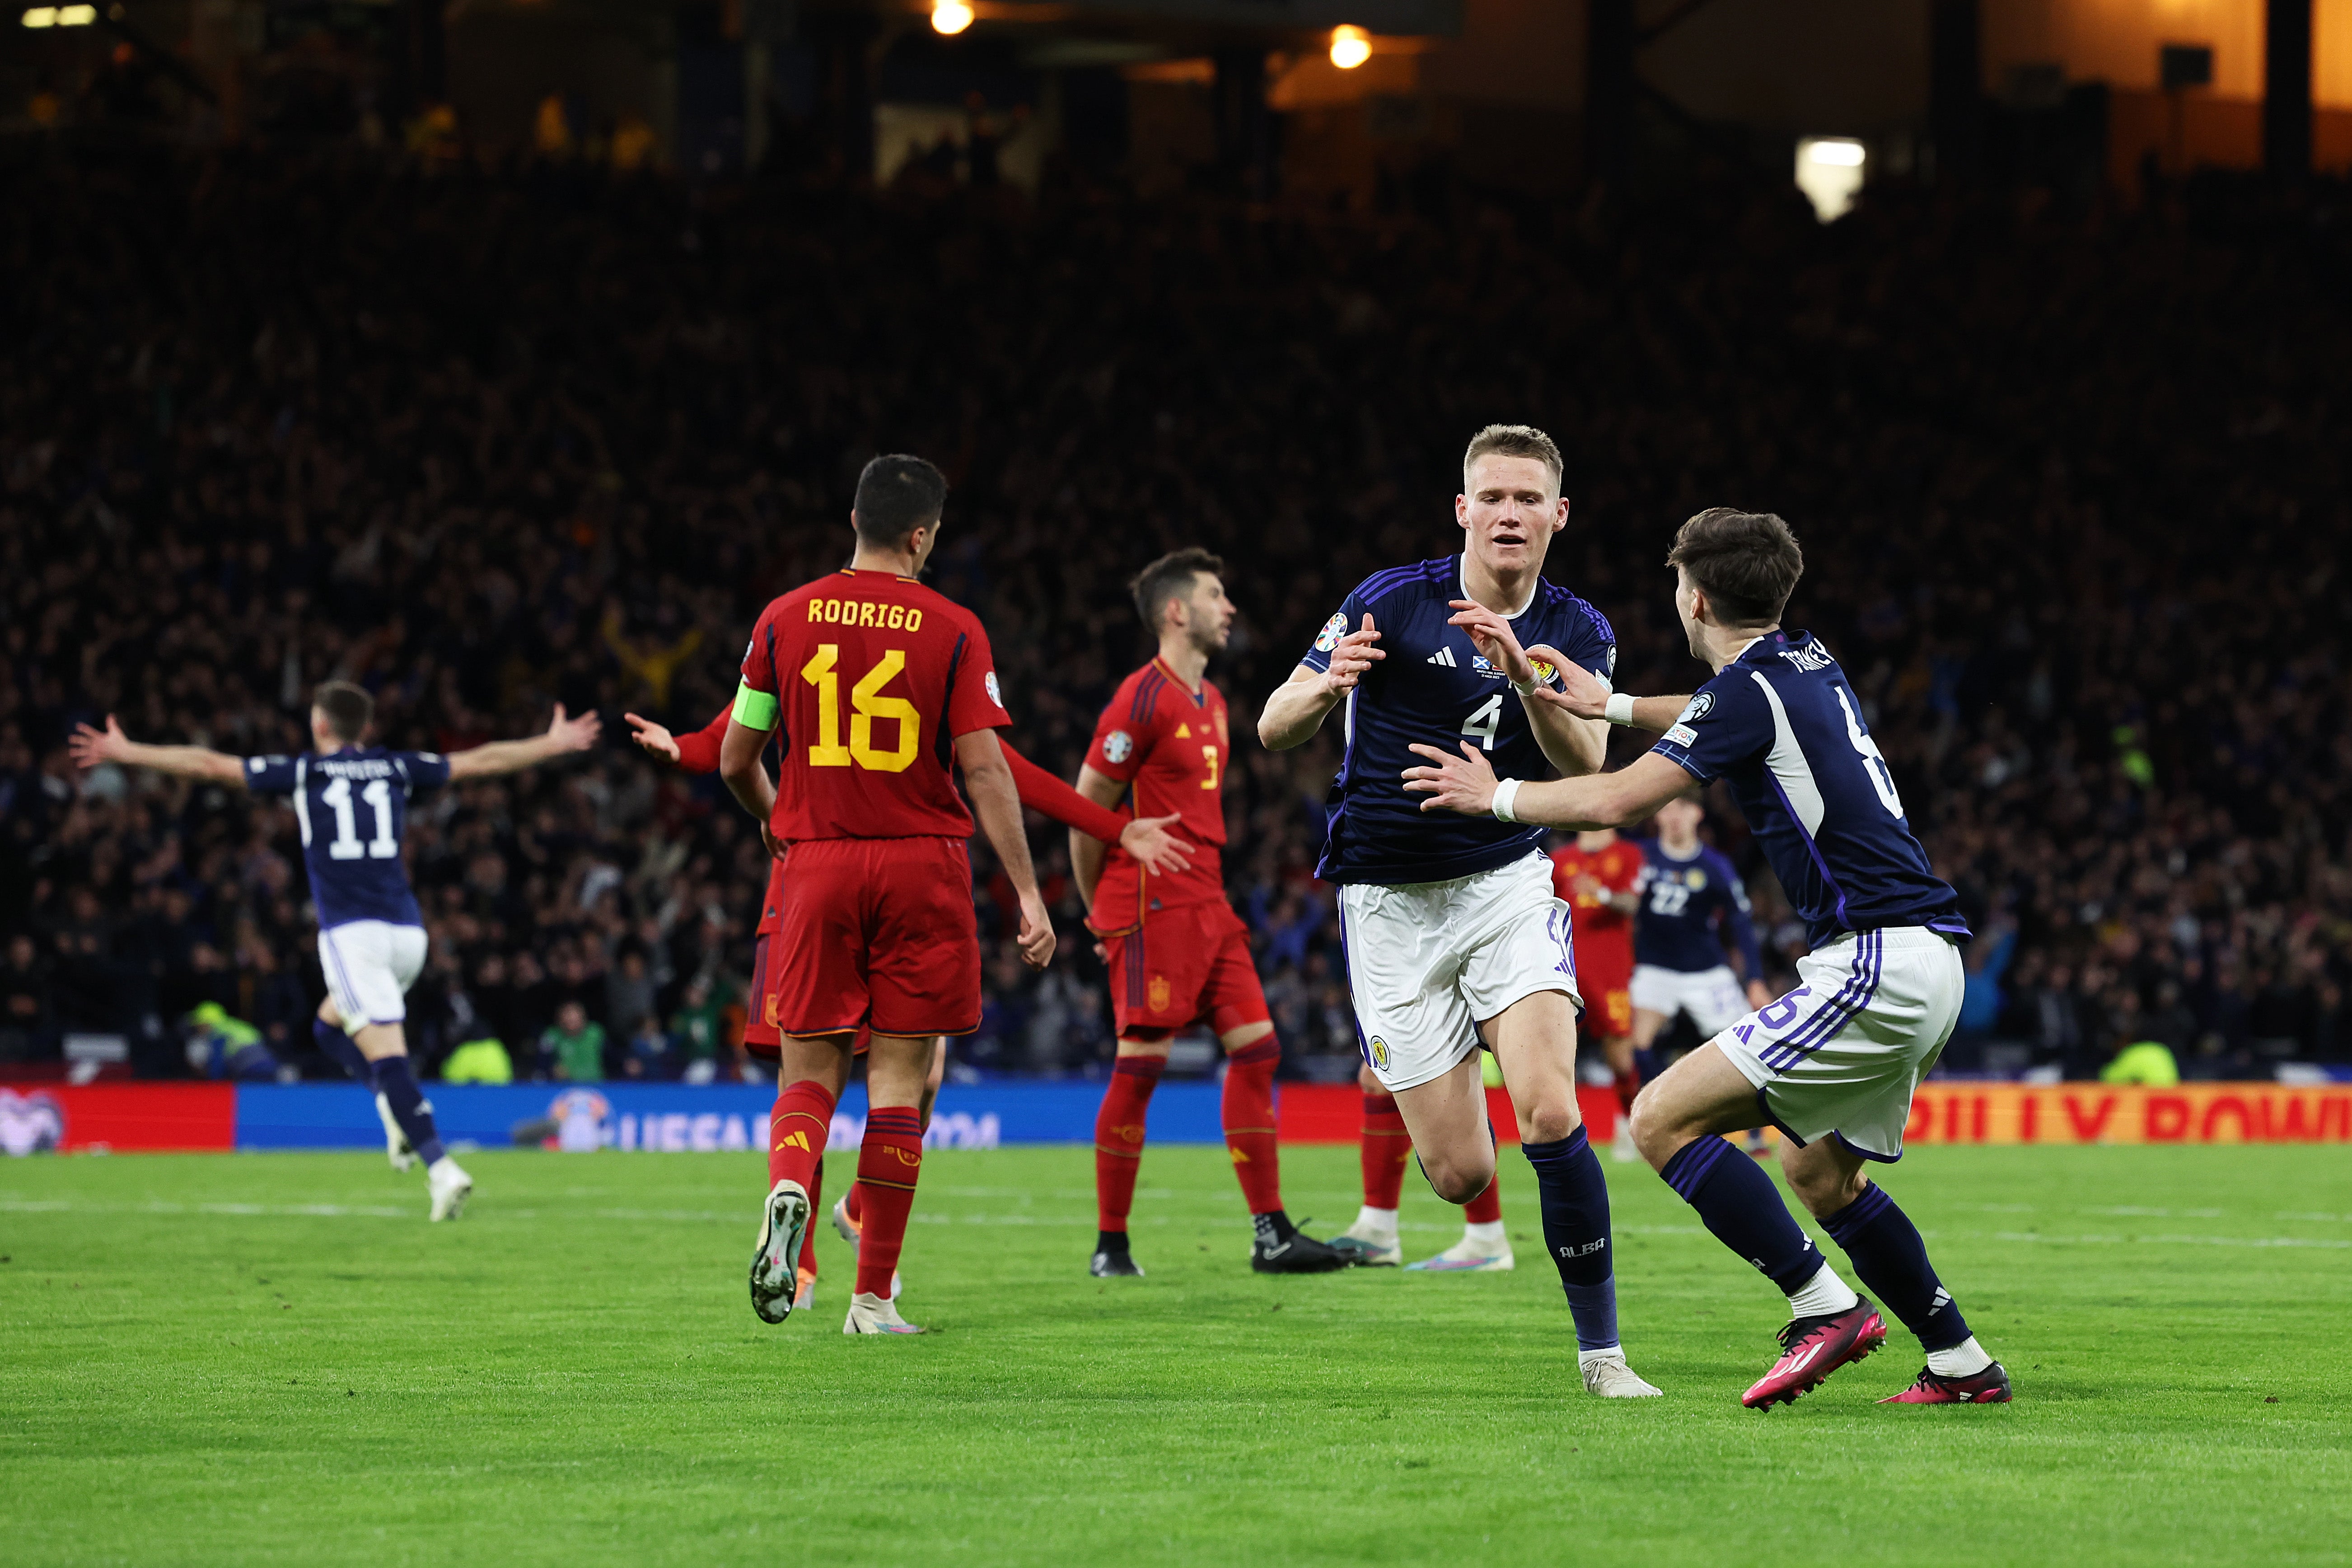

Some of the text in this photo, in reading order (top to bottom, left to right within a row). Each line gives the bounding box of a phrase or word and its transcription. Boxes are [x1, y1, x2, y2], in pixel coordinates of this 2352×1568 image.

[808, 599, 922, 632] RODRIGO
[801, 644, 920, 772] 16
[1461, 694, 1503, 750] 4
[1201, 745, 1218, 790] 3
[1834, 686, 1903, 819] 6
[322, 776, 398, 860] 11
[1559, 1237, 1608, 1258] ALBA
